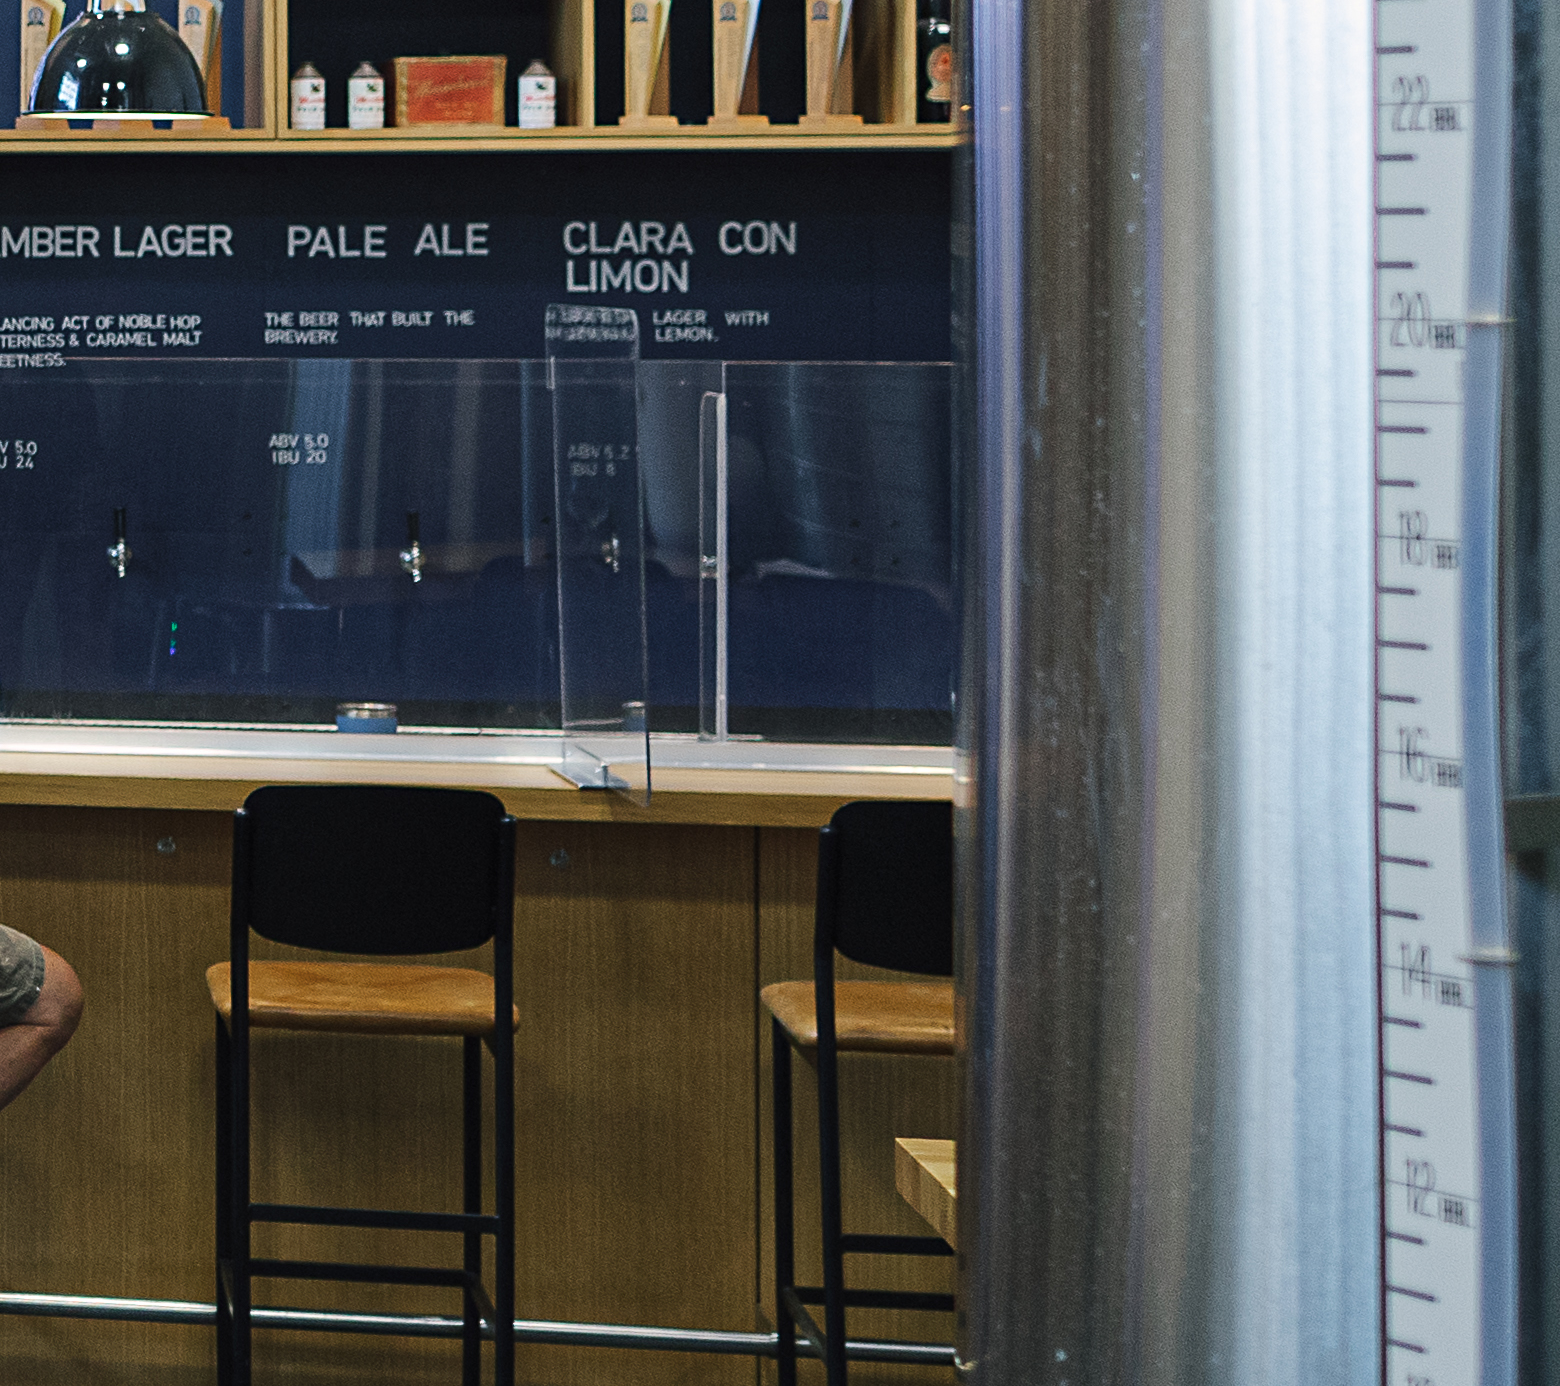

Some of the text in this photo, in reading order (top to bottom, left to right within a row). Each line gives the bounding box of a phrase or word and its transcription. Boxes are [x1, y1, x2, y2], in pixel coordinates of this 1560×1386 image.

[113, 224, 233, 257] LAGER
[287, 223, 489, 258] PALE ALE
[564, 220, 797, 254] CLARA CON
[567, 260, 688, 293] LIMON
[62, 316, 89, 330] ACT
[96, 316, 114, 330] OF
[119, 314, 166, 329] NOBLE
[170, 315, 201, 329] HOP
[265, 310, 474, 327] THE BEER THAT BUILT THE
[653, 310, 707, 325] LAGER
[725, 310, 769, 326] WITH
[69, 333, 79, 346] &
[86, 332, 156, 347] CARAMEL
[163, 331, 201, 346] MALT
[270, 434, 298, 448] ABV
[15, 456, 33, 468] 24
[272, 450, 299, 464] IBU
